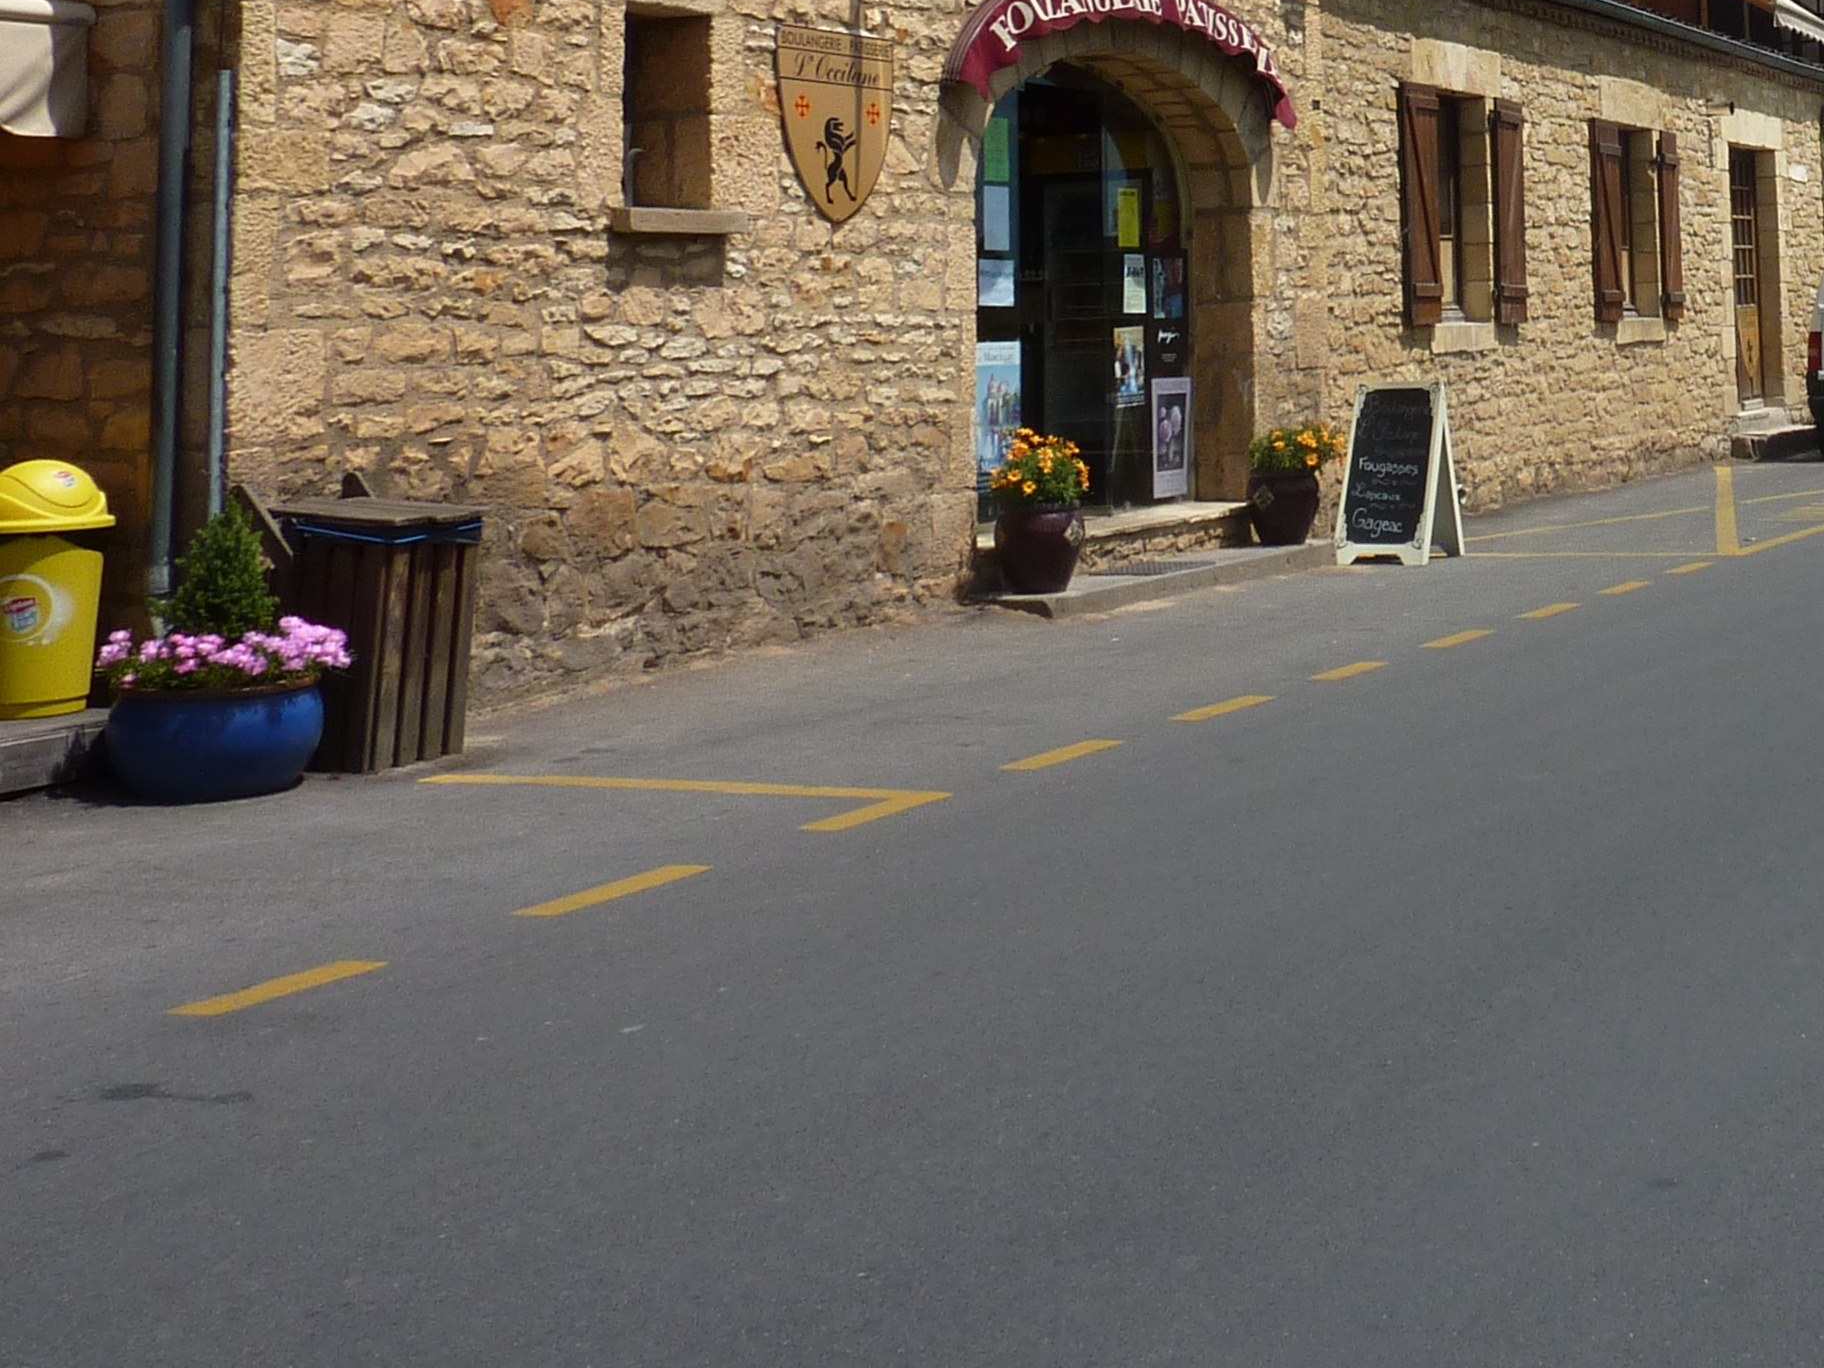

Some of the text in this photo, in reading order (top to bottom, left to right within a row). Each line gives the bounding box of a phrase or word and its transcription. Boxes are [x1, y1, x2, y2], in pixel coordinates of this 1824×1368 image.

[781, 30, 843, 51] BOULANGERIE
[1358, 456, 1419, 478] Fougasses
[1352, 507, 1403, 538] Gageac
